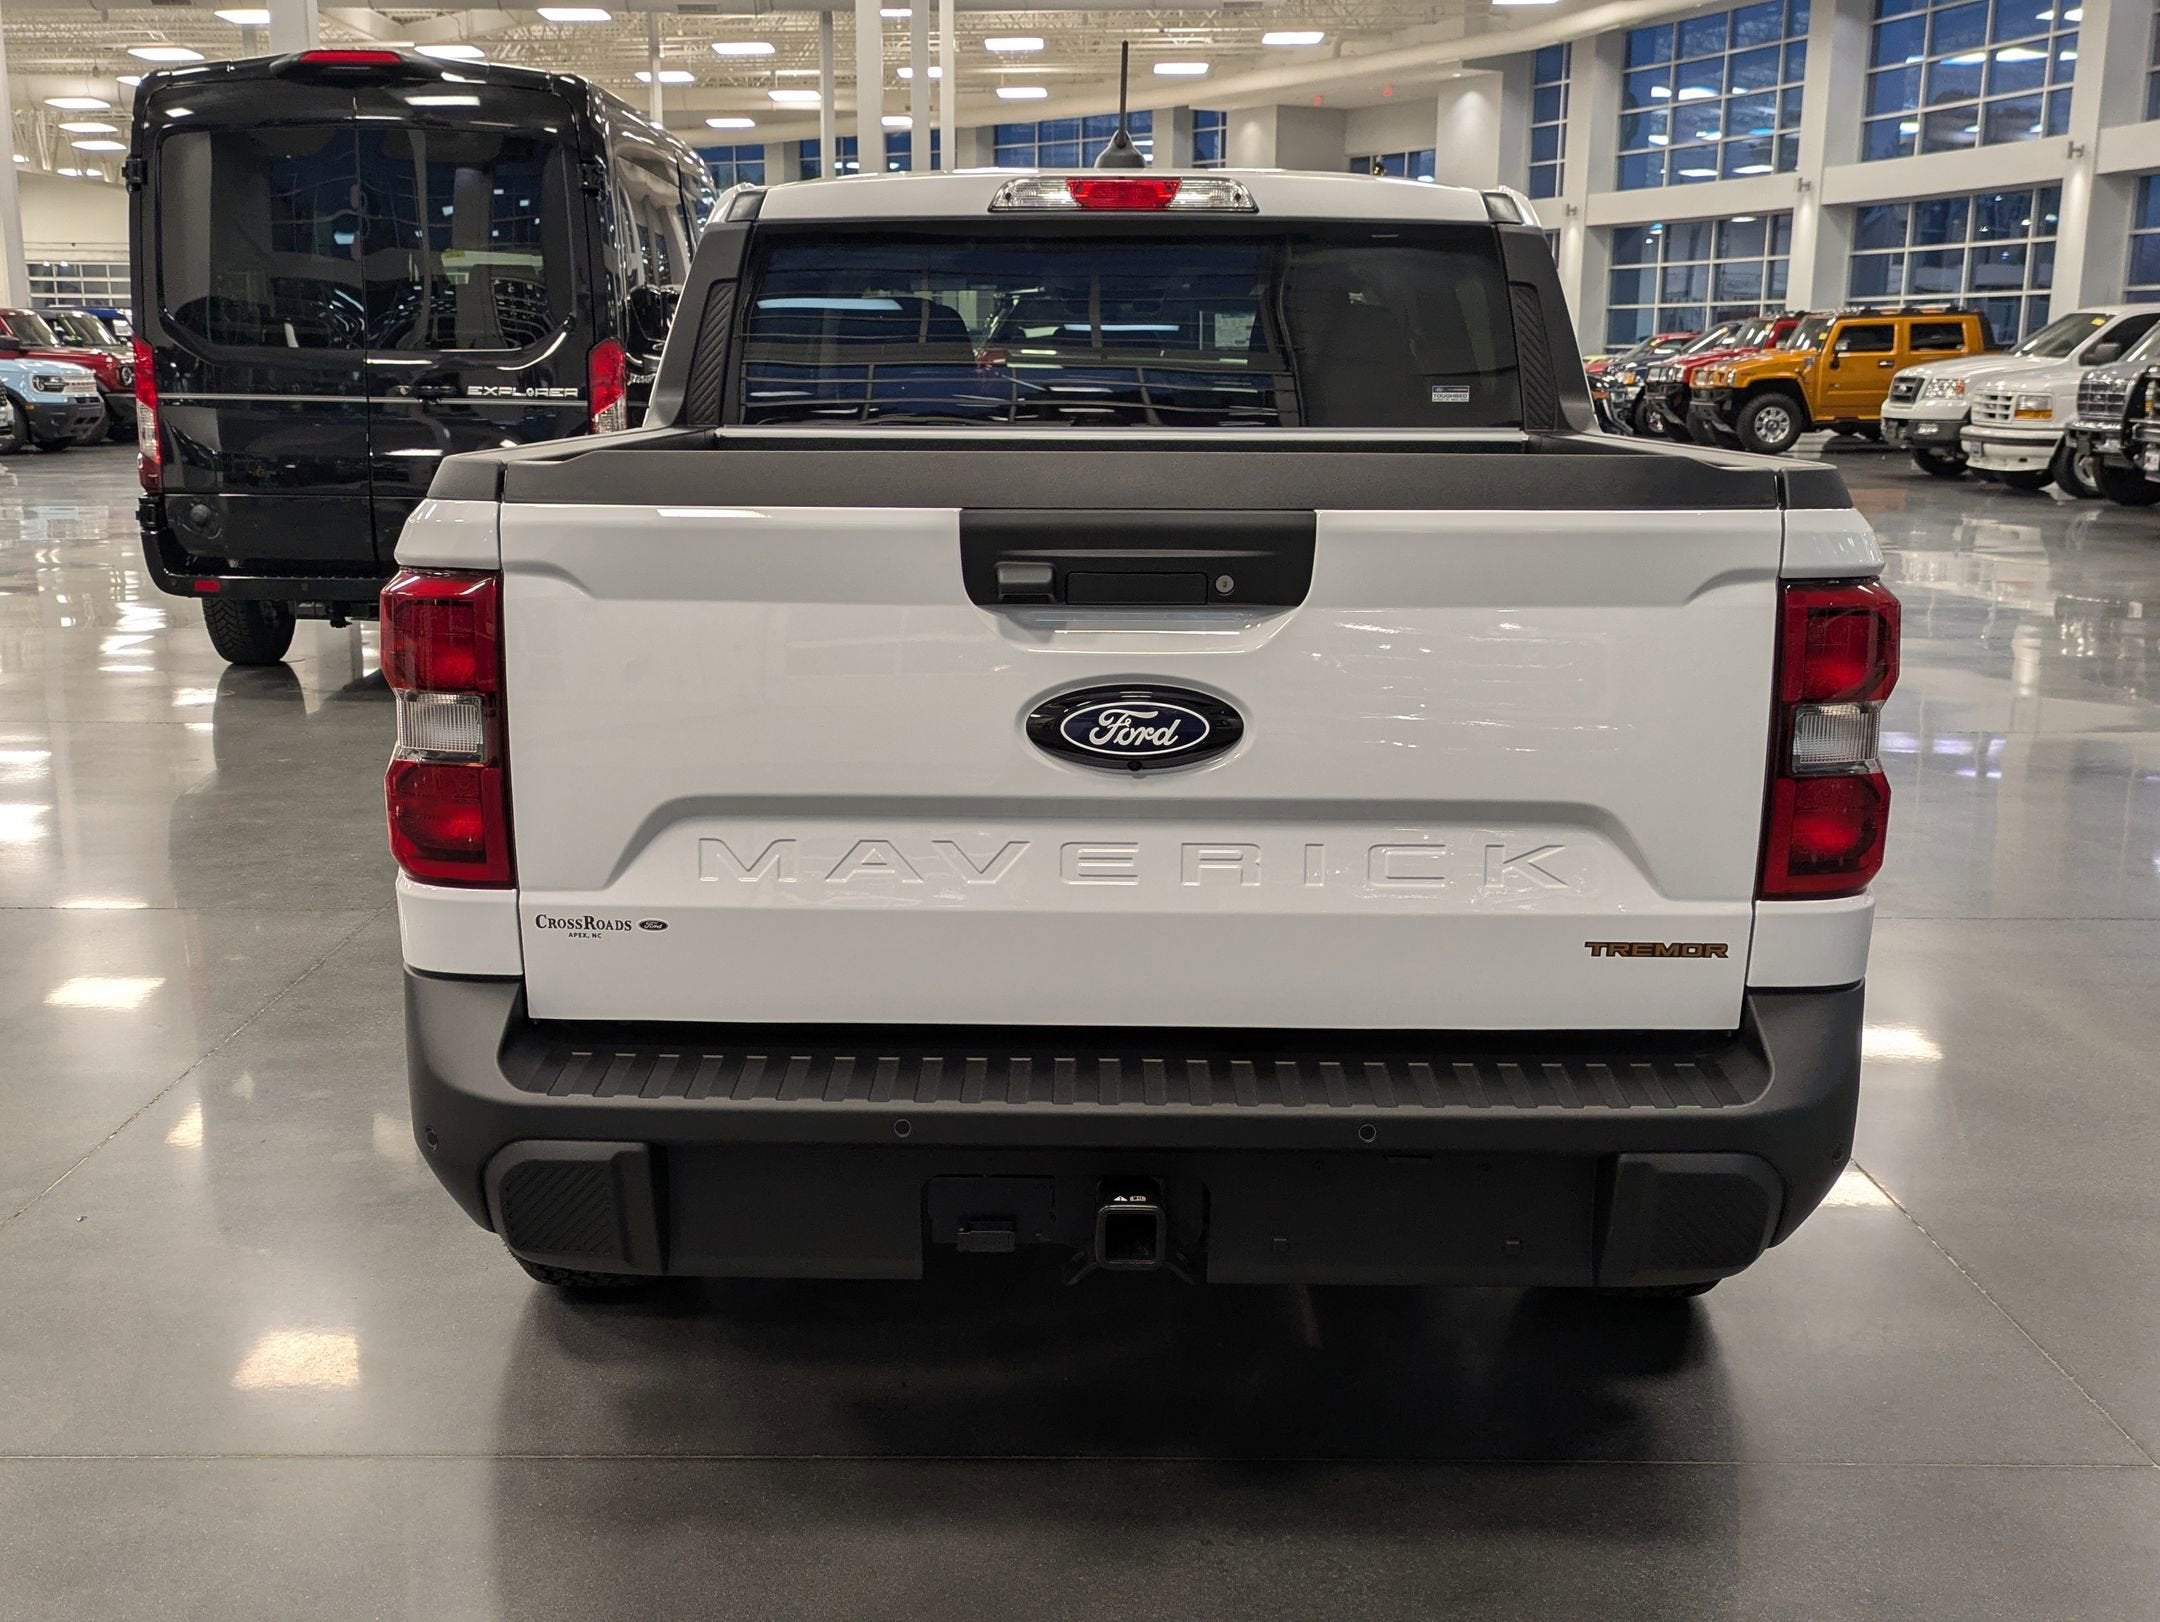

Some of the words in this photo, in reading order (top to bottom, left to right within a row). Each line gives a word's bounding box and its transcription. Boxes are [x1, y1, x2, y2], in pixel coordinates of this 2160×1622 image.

[467, 385, 579, 398] EXPLORER
[1088, 708, 1181, 747] Ford
[699, 837, 1568, 888] MAVERICK
[1584, 941, 1729, 959] TREMOR
